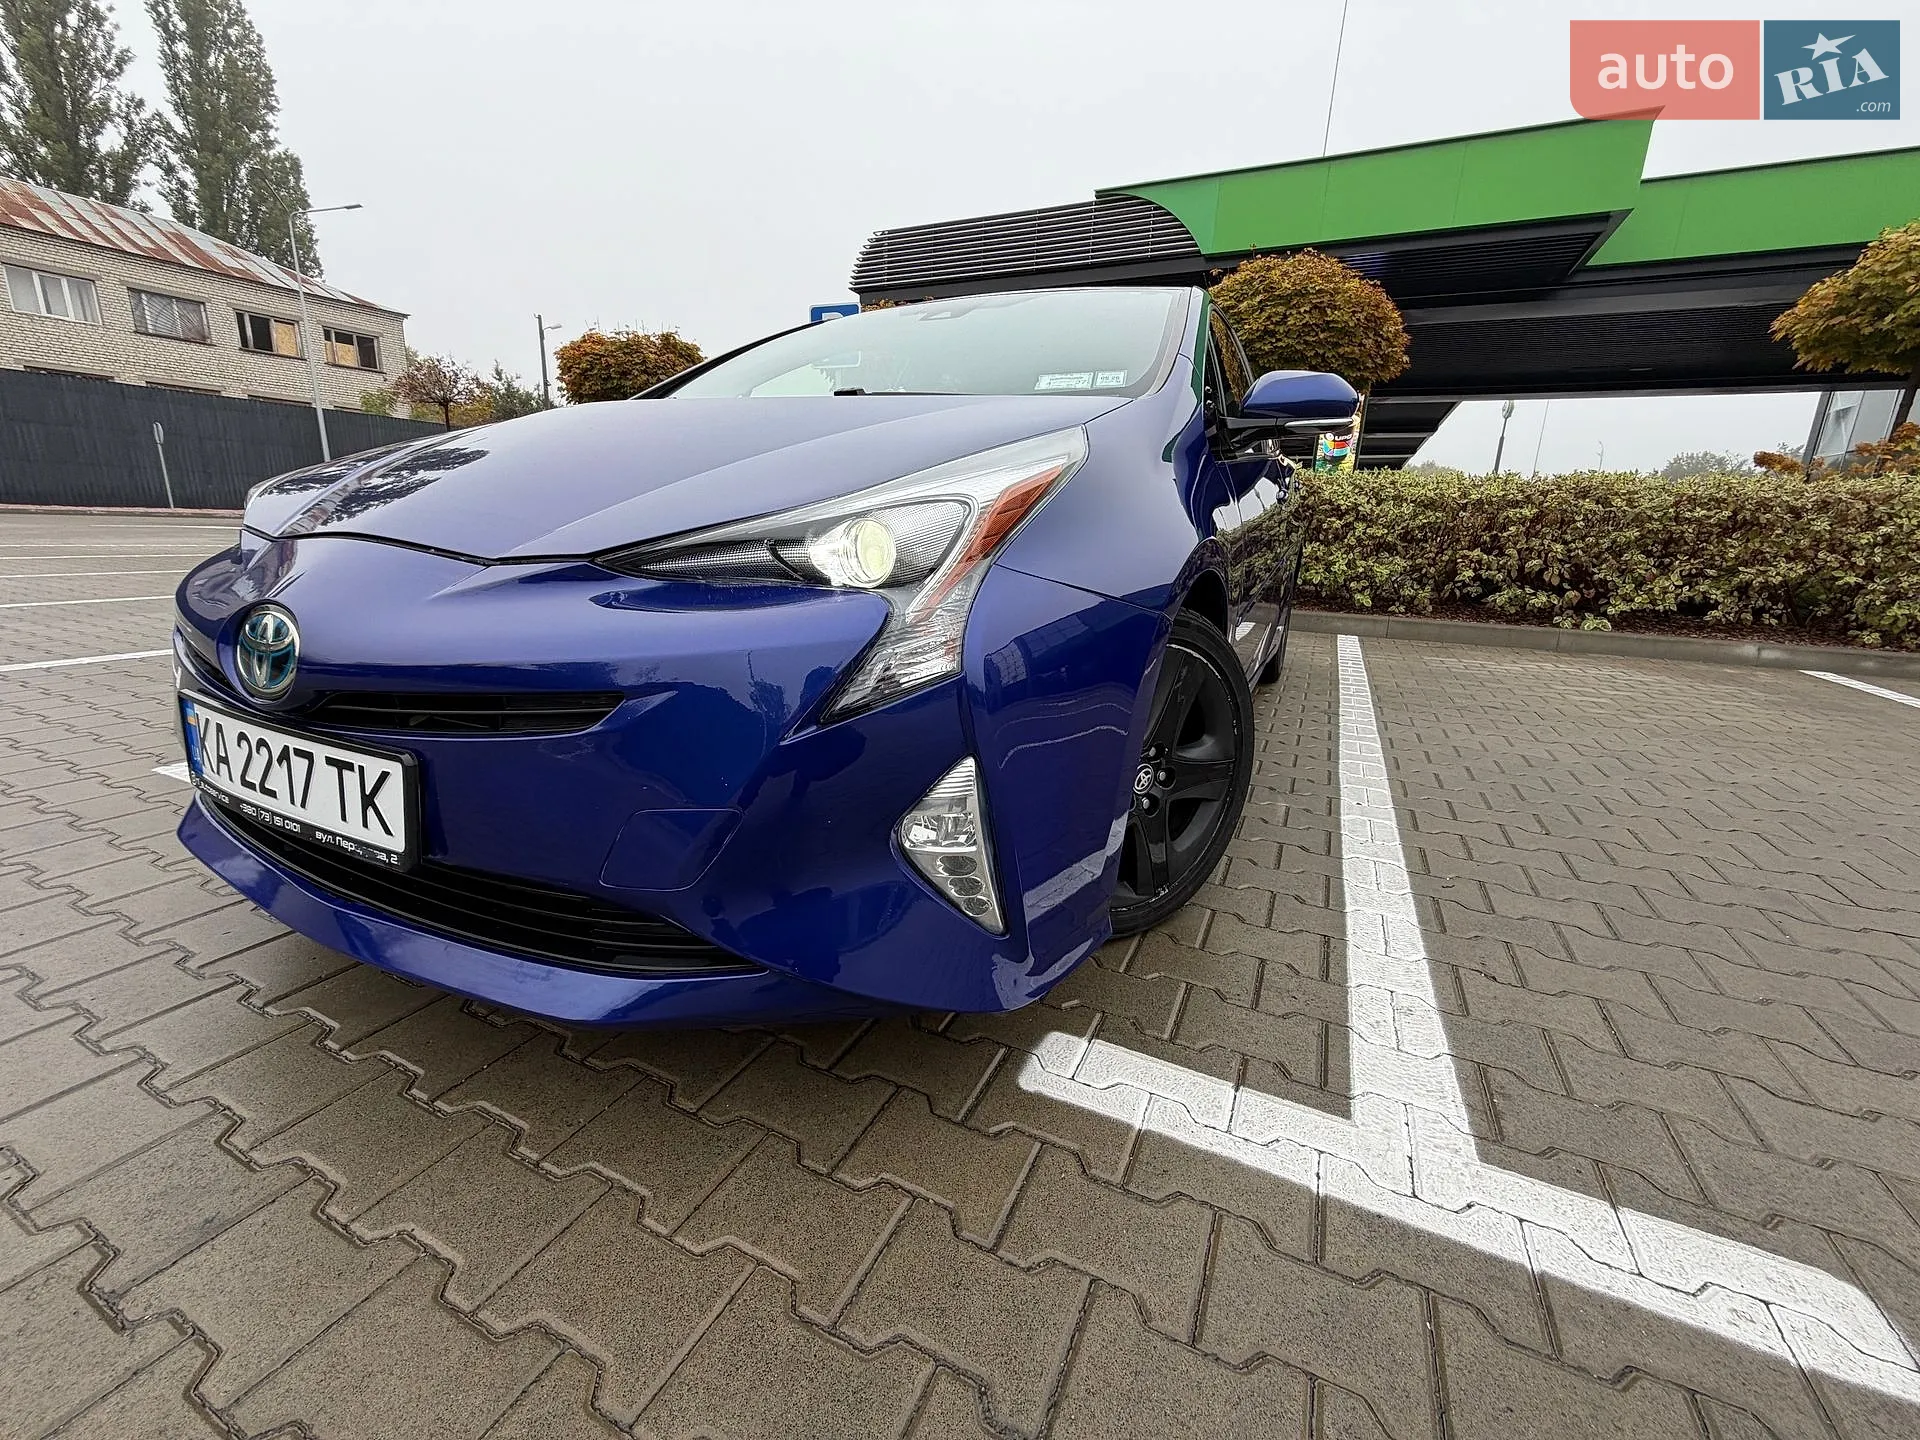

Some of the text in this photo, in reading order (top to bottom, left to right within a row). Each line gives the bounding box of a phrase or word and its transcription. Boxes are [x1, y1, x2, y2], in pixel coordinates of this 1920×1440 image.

[196, 712, 395, 838] KA 2217 TK
[257, 807, 273, 825] (73)
